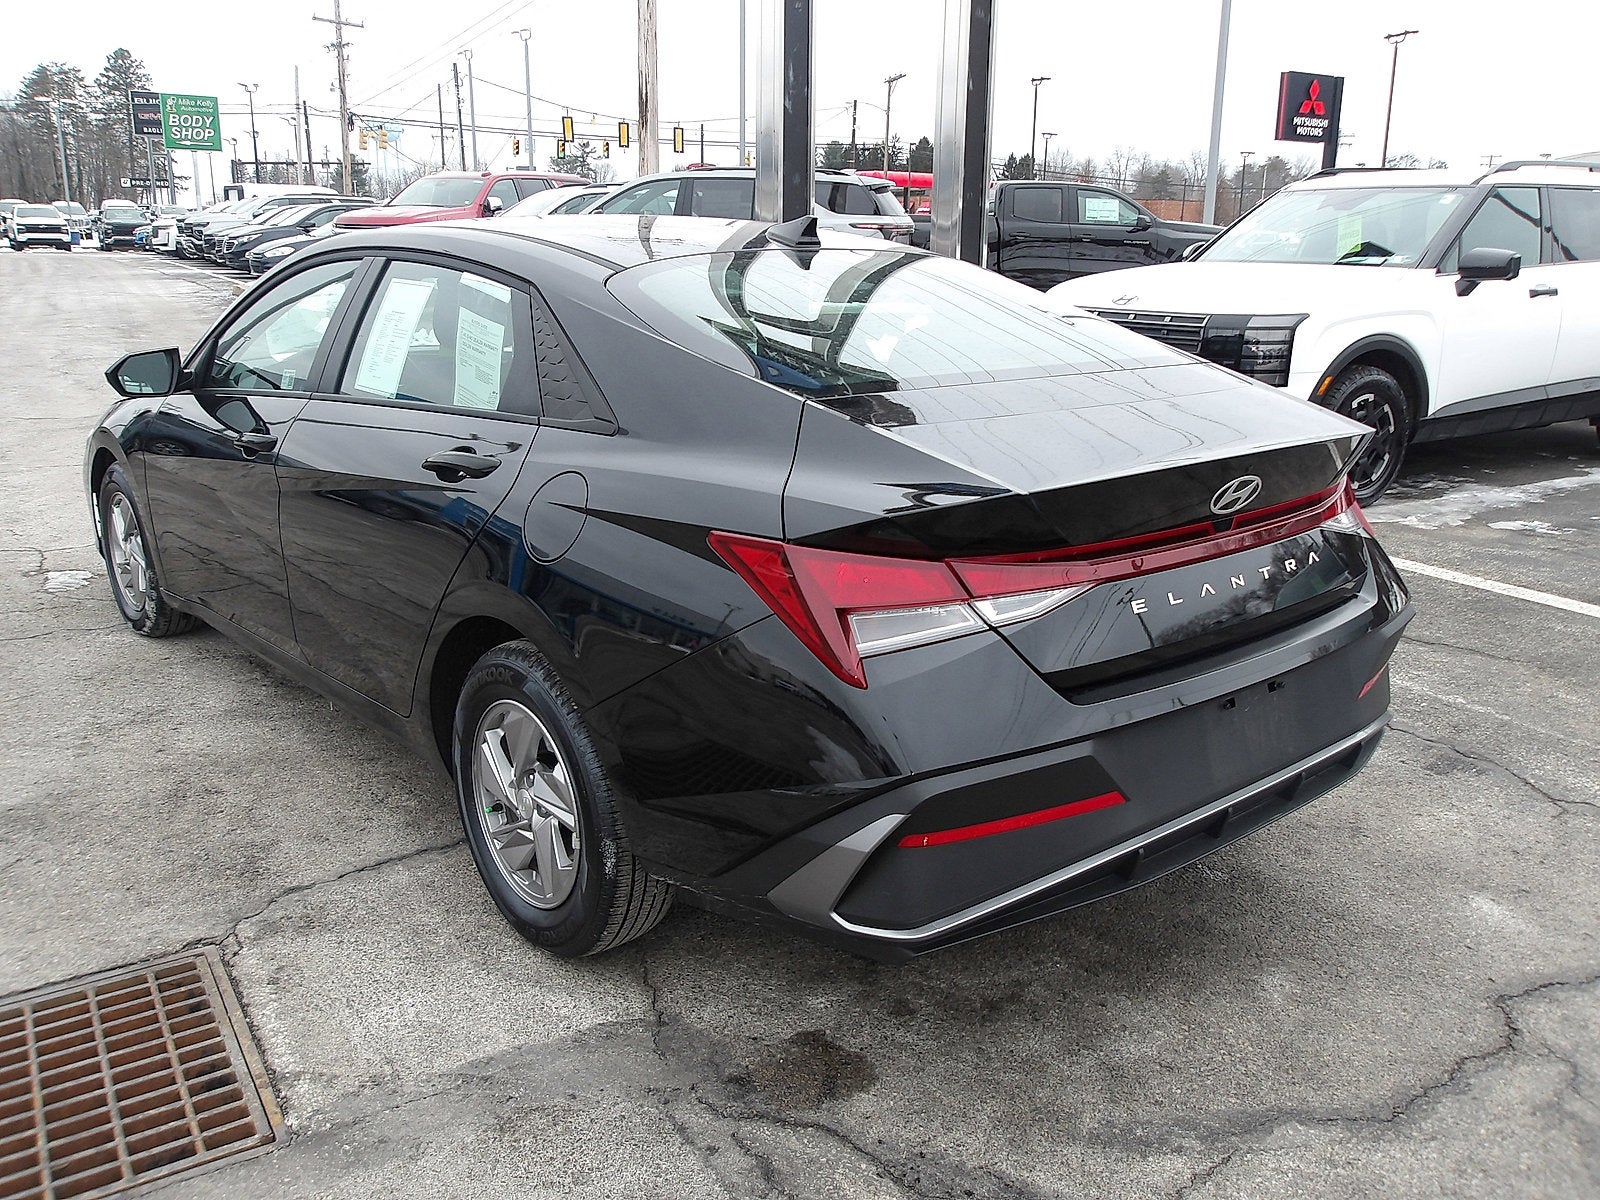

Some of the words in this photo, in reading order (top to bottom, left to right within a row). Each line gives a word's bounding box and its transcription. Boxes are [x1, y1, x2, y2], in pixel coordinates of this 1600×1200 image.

[134, 97, 160, 105] BUIC
[179, 98, 195, 106] Mike
[197, 99, 214, 109] Kelly
[169, 113, 214, 127] BODY
[1293, 116, 1329, 128] MITSUBISHI
[171, 126, 215, 141] SHOP
[1296, 126, 1324, 137] MOTORS
[1130, 551, 1320, 615] ELANTRA
